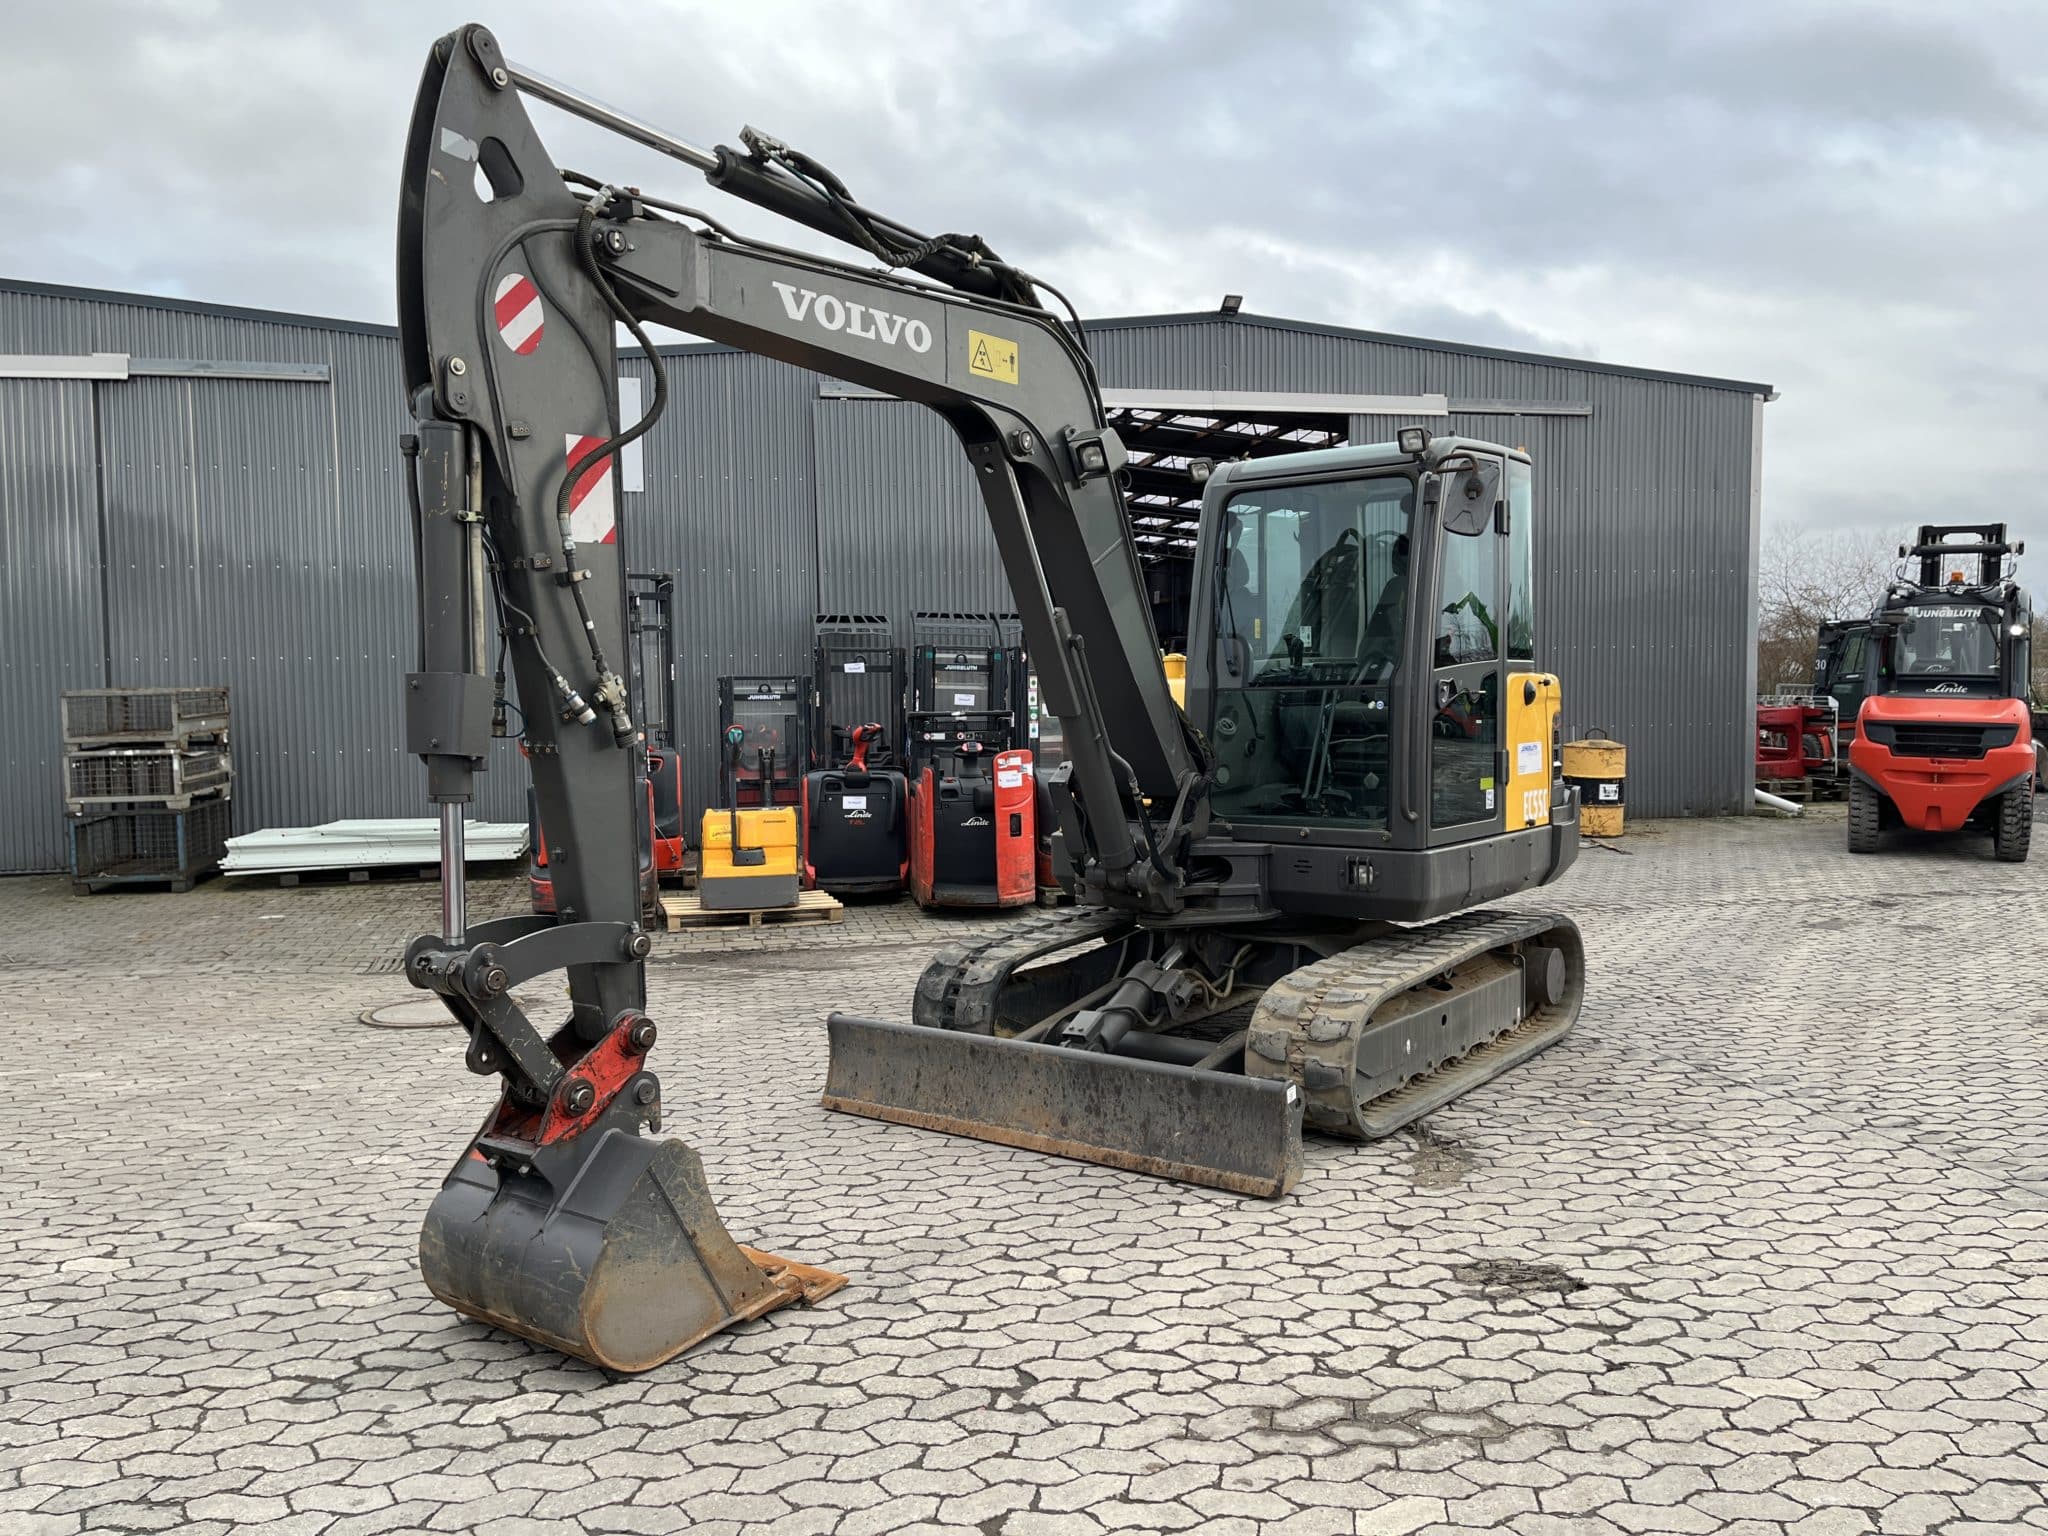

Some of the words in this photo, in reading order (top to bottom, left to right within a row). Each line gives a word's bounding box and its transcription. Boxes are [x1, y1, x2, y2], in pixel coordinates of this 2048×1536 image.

[772, 281, 932, 353] VOLVO
[1916, 608, 1981, 618] JUNGBLUTH
[1815, 659, 1827, 670] 30
[1925, 681, 1968, 693] Linde
[844, 809, 873, 818] Linde
[960, 816, 990, 826] Linde
